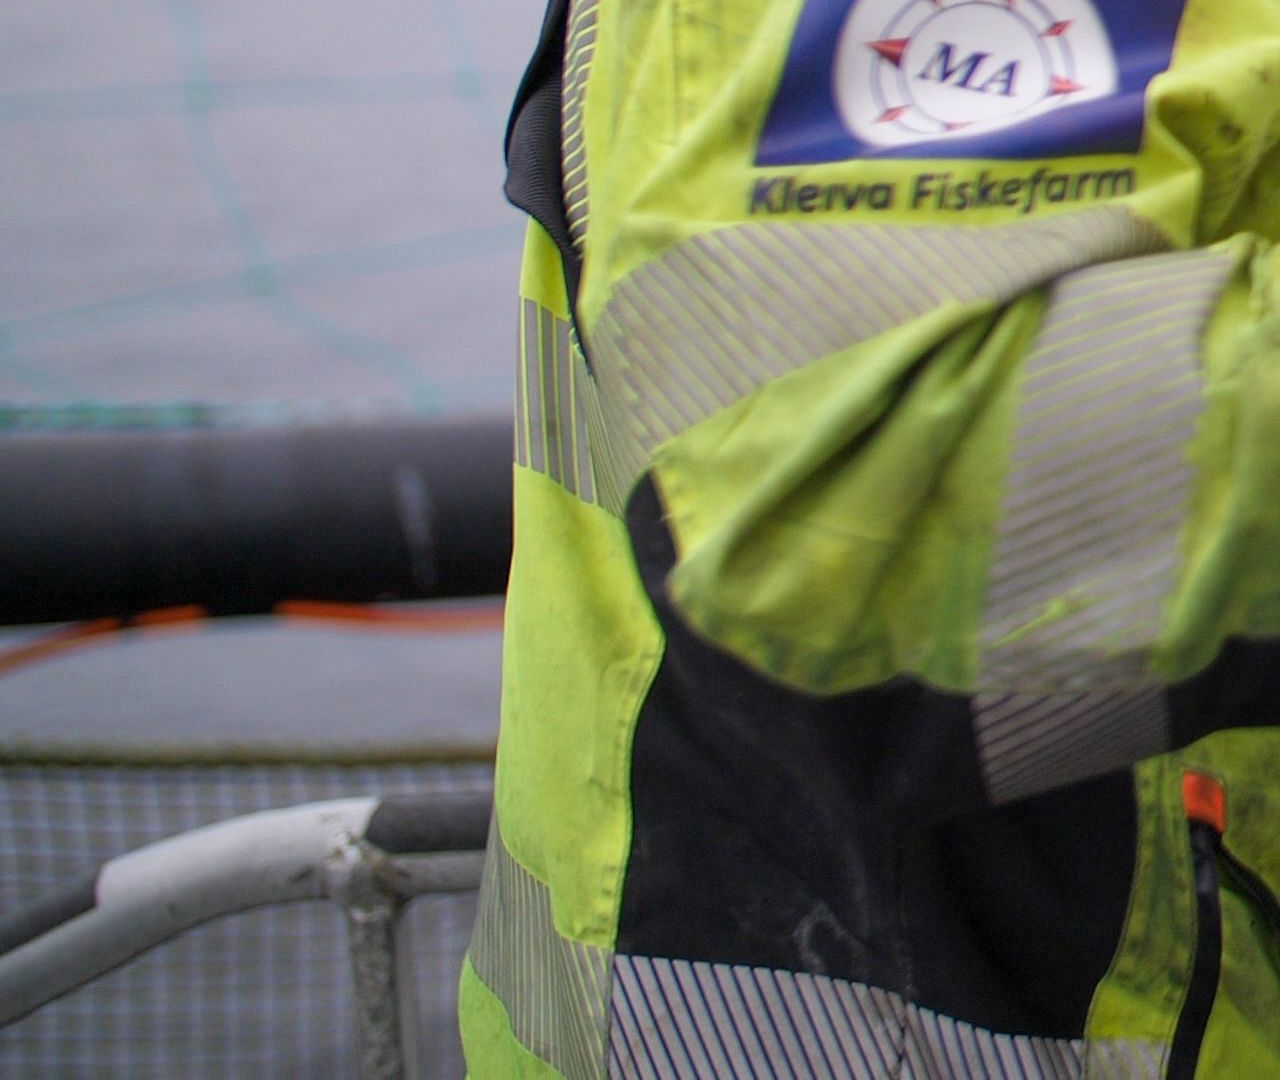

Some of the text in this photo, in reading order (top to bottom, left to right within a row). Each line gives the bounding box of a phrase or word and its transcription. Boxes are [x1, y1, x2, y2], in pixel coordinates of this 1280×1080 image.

[915, 41, 1022, 97] MA
[749, 168, 1134, 215] Kleiva Fiskefarm
